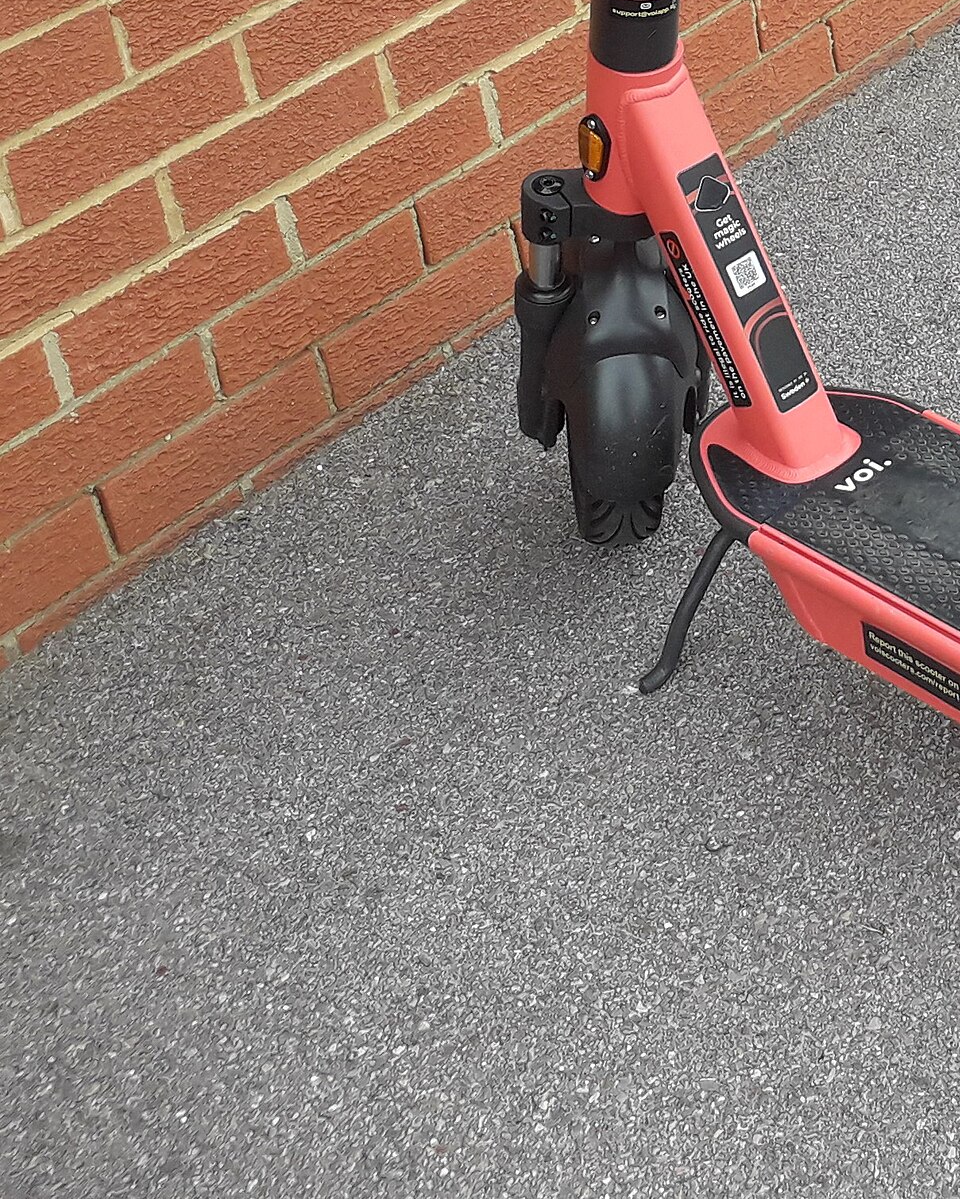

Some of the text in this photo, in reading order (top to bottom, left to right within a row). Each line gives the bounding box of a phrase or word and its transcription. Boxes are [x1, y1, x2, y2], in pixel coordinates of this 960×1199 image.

[713, 219, 741, 240] magic
[715, 213, 733, 228] Get
[714, 227, 747, 250] wheels
[681, 262, 692, 280] UK
[737, 385, 746, 400] on
[834, 457, 893, 494] voi.
[868, 630, 960, 691] Report this scooter on
